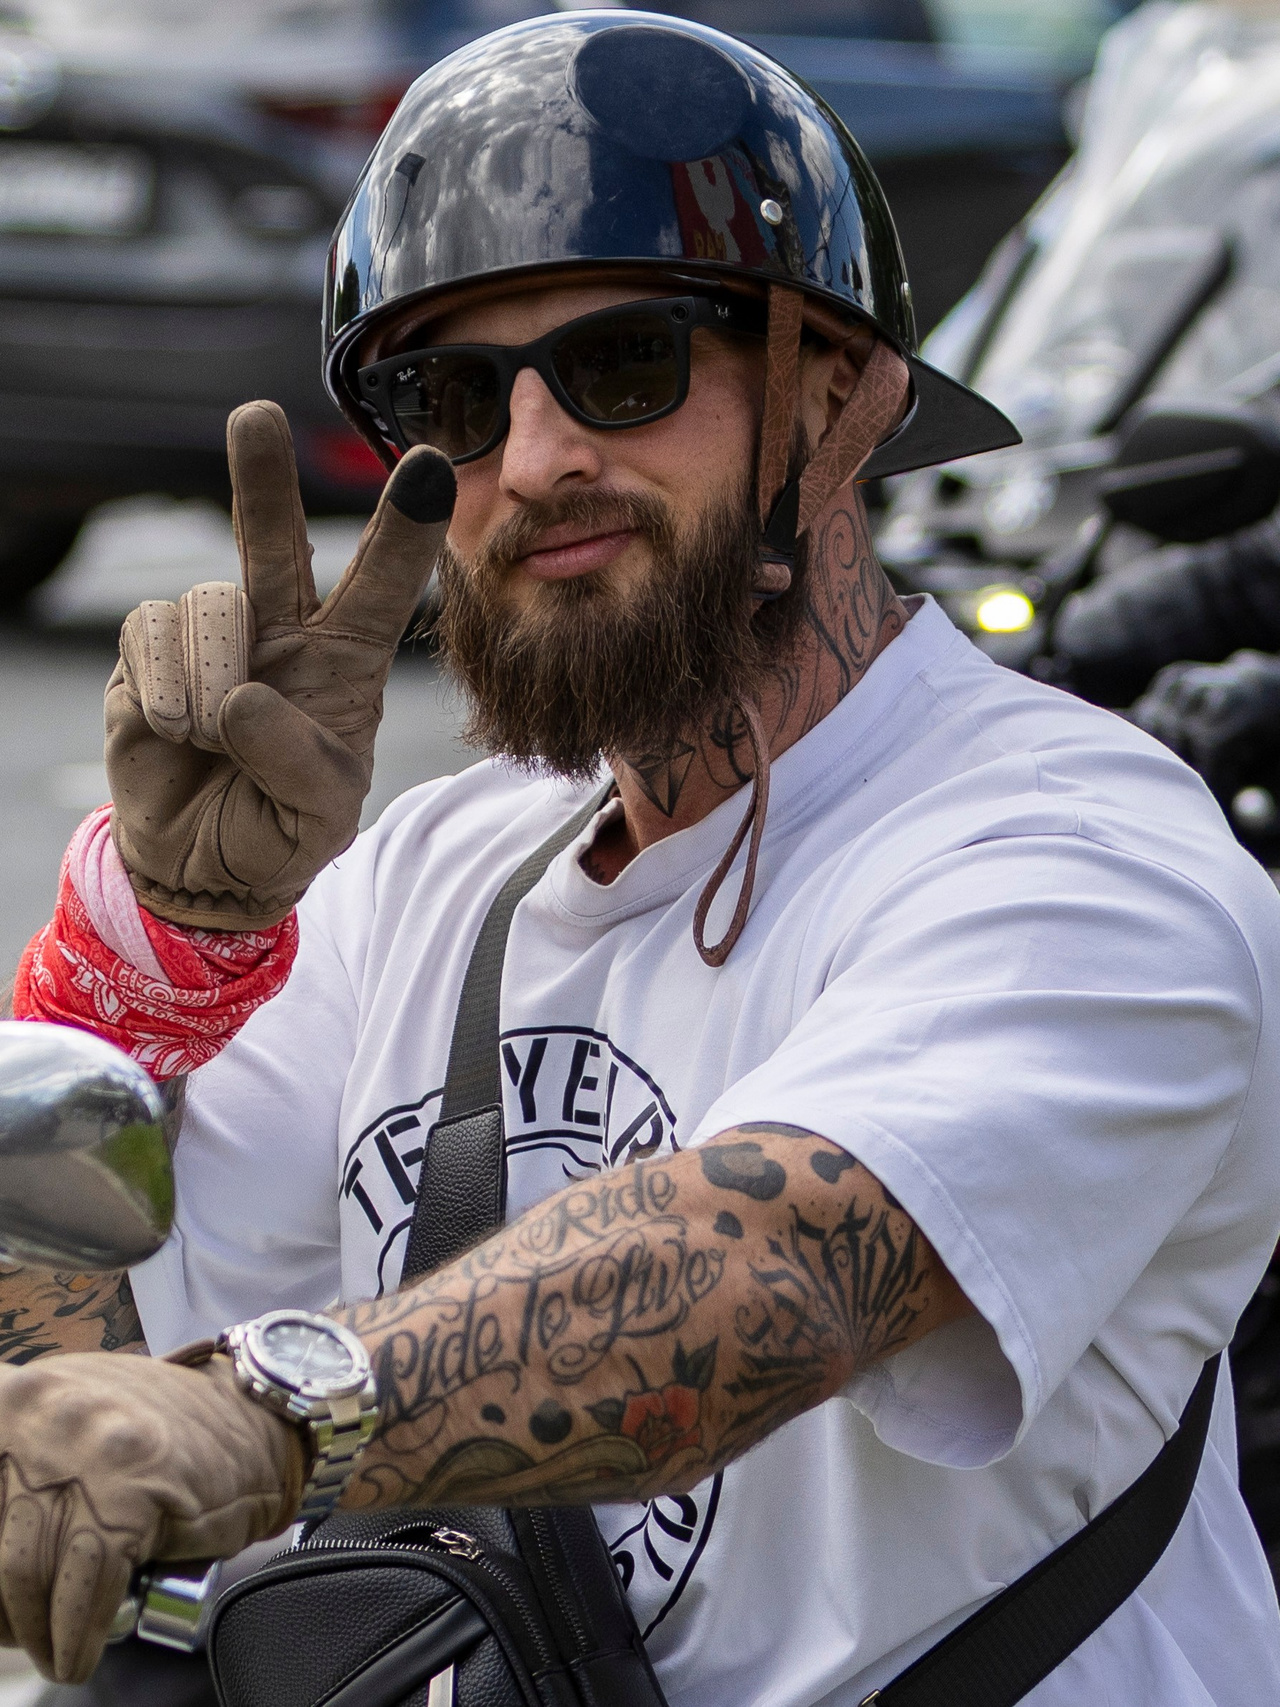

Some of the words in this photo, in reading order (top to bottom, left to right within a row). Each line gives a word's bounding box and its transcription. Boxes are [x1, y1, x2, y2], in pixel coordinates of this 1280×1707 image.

[517, 1162, 677, 1257] Ride
[372, 1274, 520, 1425] Ride
[513, 1262, 577, 1368] To
[549, 1226, 727, 1386] Live
